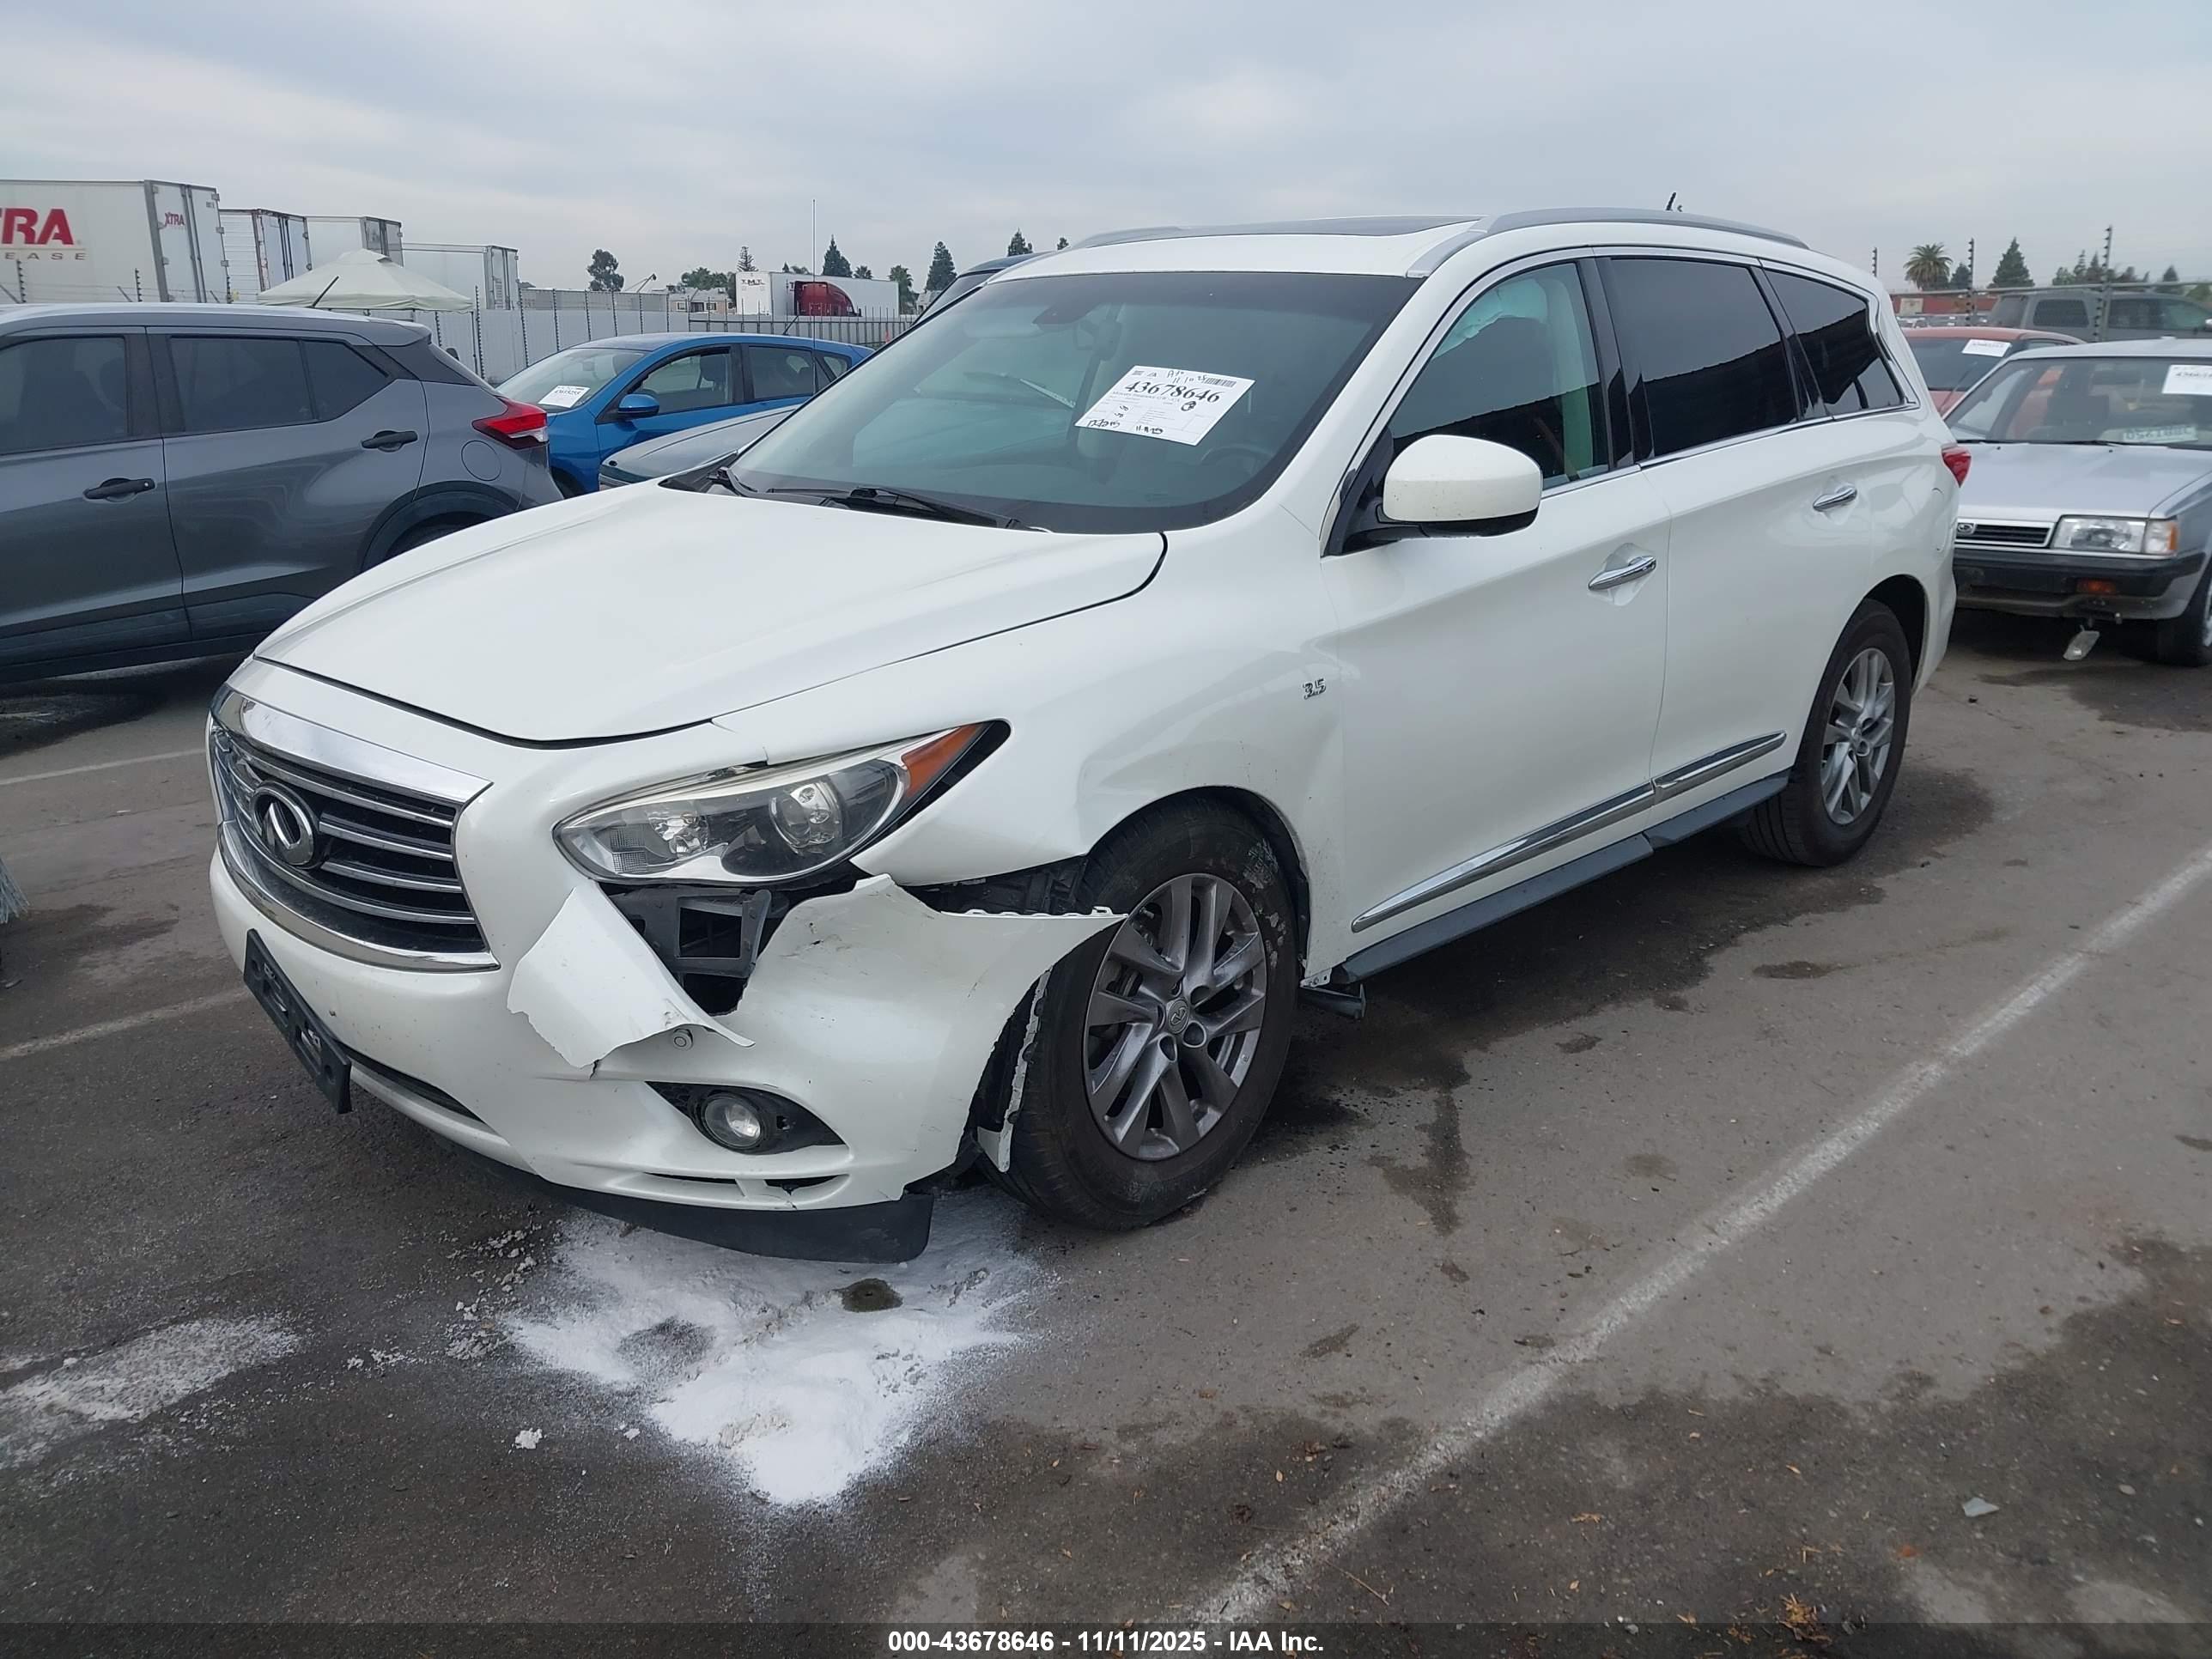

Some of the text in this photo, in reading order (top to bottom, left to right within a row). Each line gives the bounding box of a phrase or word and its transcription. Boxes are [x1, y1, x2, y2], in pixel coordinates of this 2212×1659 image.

[0, 208, 74, 245] RA
[165, 212, 185, 225] XTRA
[1125, 380, 1225, 403] 43678646
